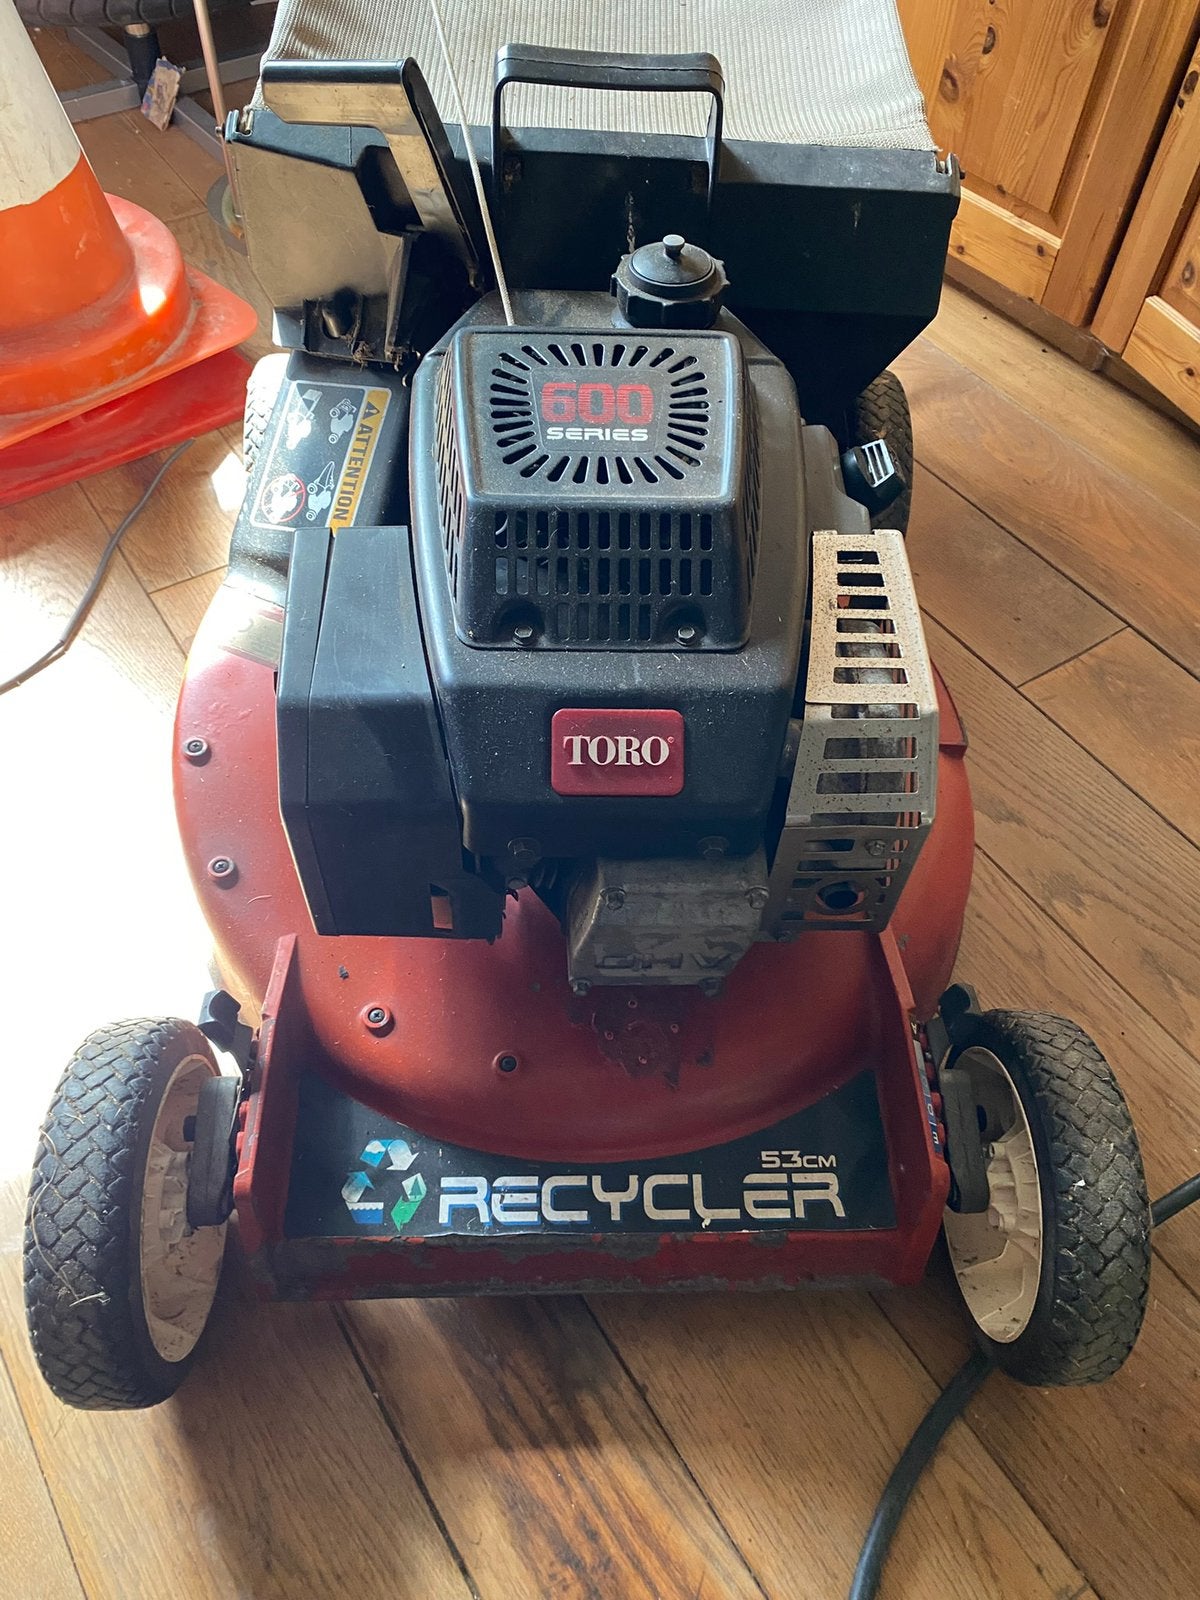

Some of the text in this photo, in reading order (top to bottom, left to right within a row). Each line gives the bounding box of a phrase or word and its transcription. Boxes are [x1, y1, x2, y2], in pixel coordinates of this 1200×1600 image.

[541, 382, 654, 425] 600
[546, 427, 648, 441] SERIES
[333, 423, 374, 521] ATTENTION
[563, 734, 670, 766] TORO
[438, 1172, 846, 1225] RECYCLER
